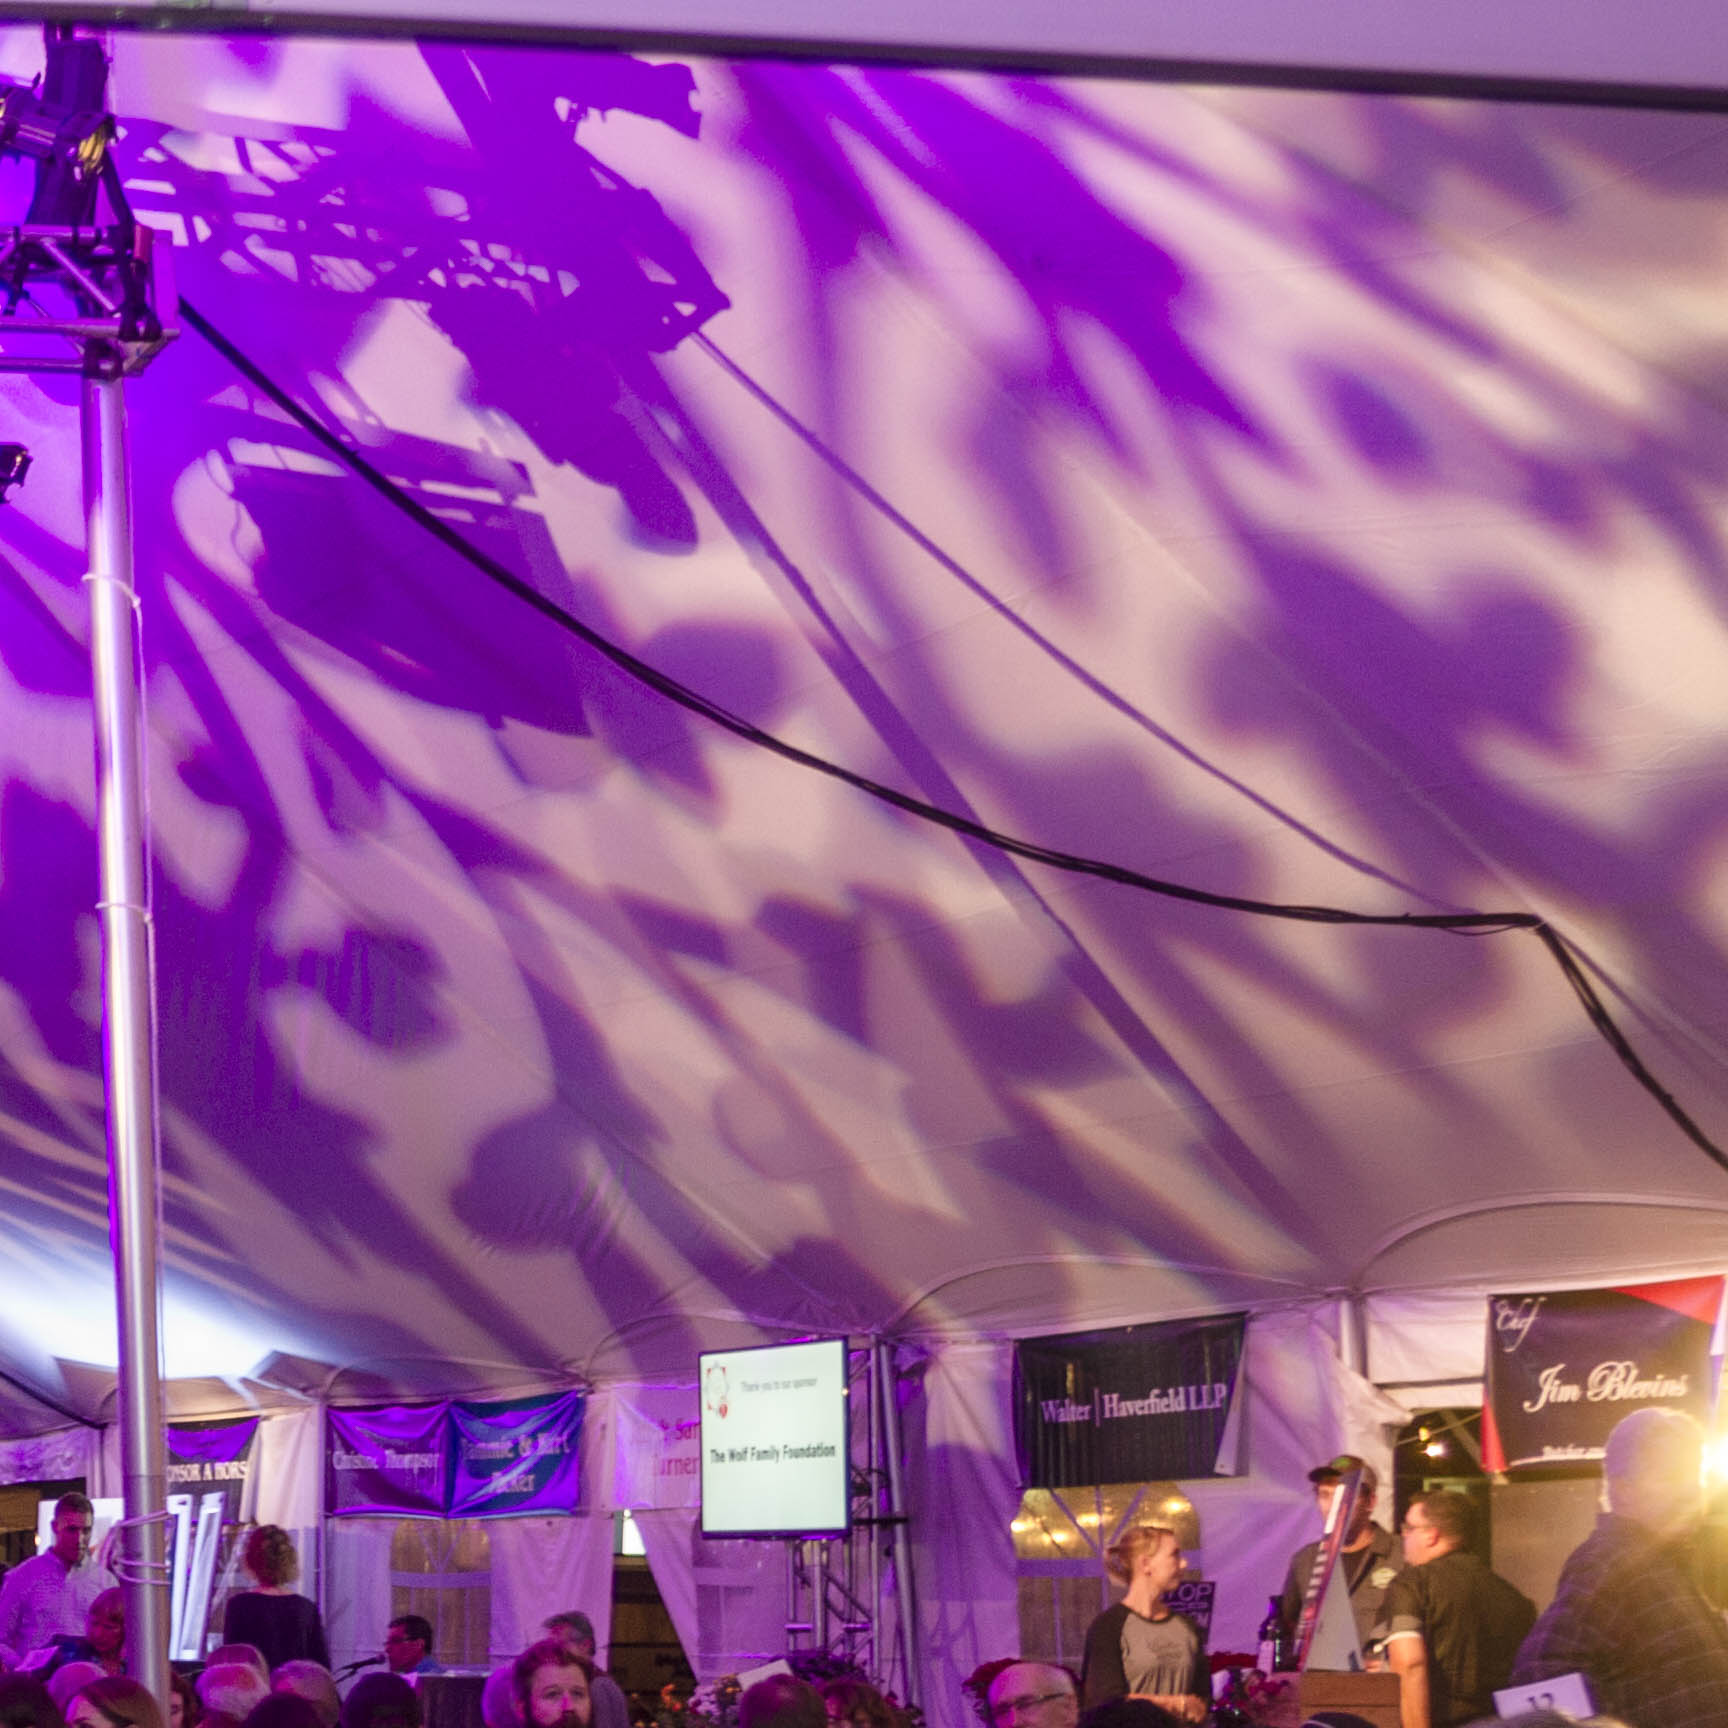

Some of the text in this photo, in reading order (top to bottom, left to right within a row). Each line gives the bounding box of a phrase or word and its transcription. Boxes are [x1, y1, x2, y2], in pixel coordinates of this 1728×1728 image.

[1041, 1383, 1227, 1424] Walter Haverfield LLP
[1523, 1361, 1689, 1413] Jim Blevins
[710, 1443, 836, 1463] The Wolf Family Foundation
